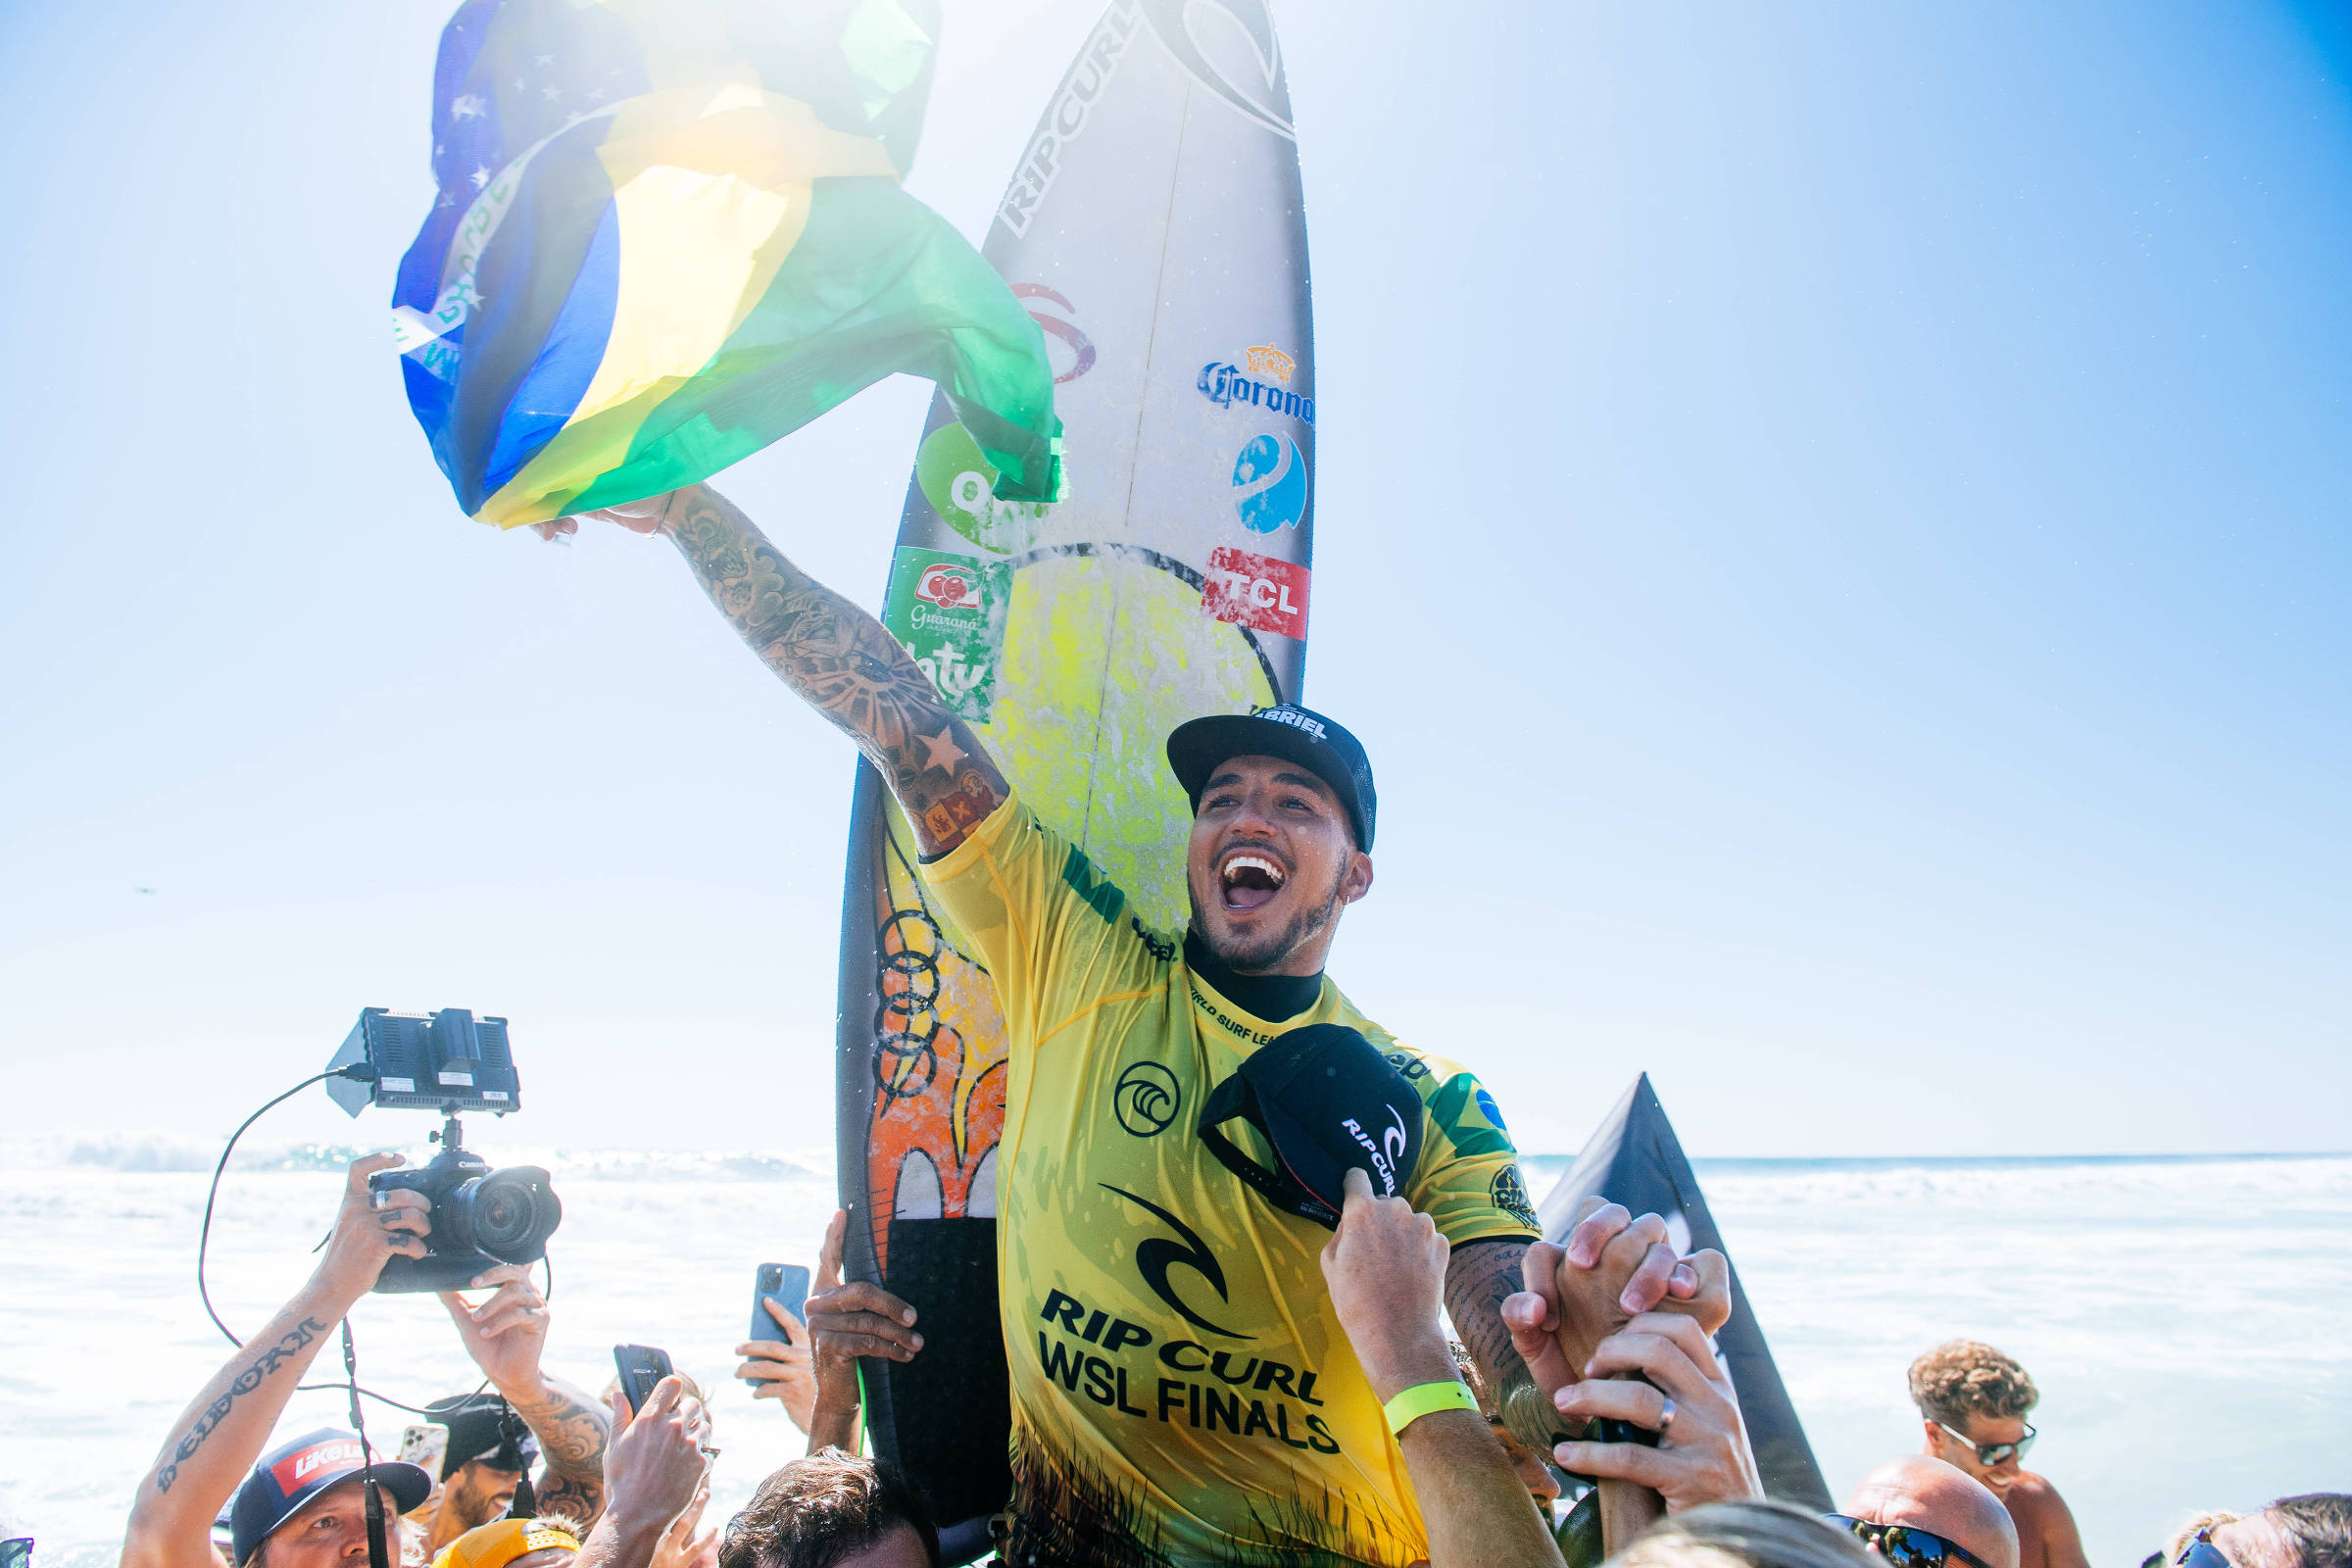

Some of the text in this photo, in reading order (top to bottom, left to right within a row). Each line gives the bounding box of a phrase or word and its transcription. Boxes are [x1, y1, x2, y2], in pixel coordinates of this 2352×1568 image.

[1001, 12, 1140, 234] RIP CURL
[1197, 362, 1315, 425] Corona
[1224, 570, 1298, 615] TCL
[1217, 1014, 1251, 1039] SURF
[1341, 1118, 1377, 1152] RIP
[1040, 1288, 1324, 1407] RIP CURL
[1039, 1330, 1341, 1454] WSL FINALS
